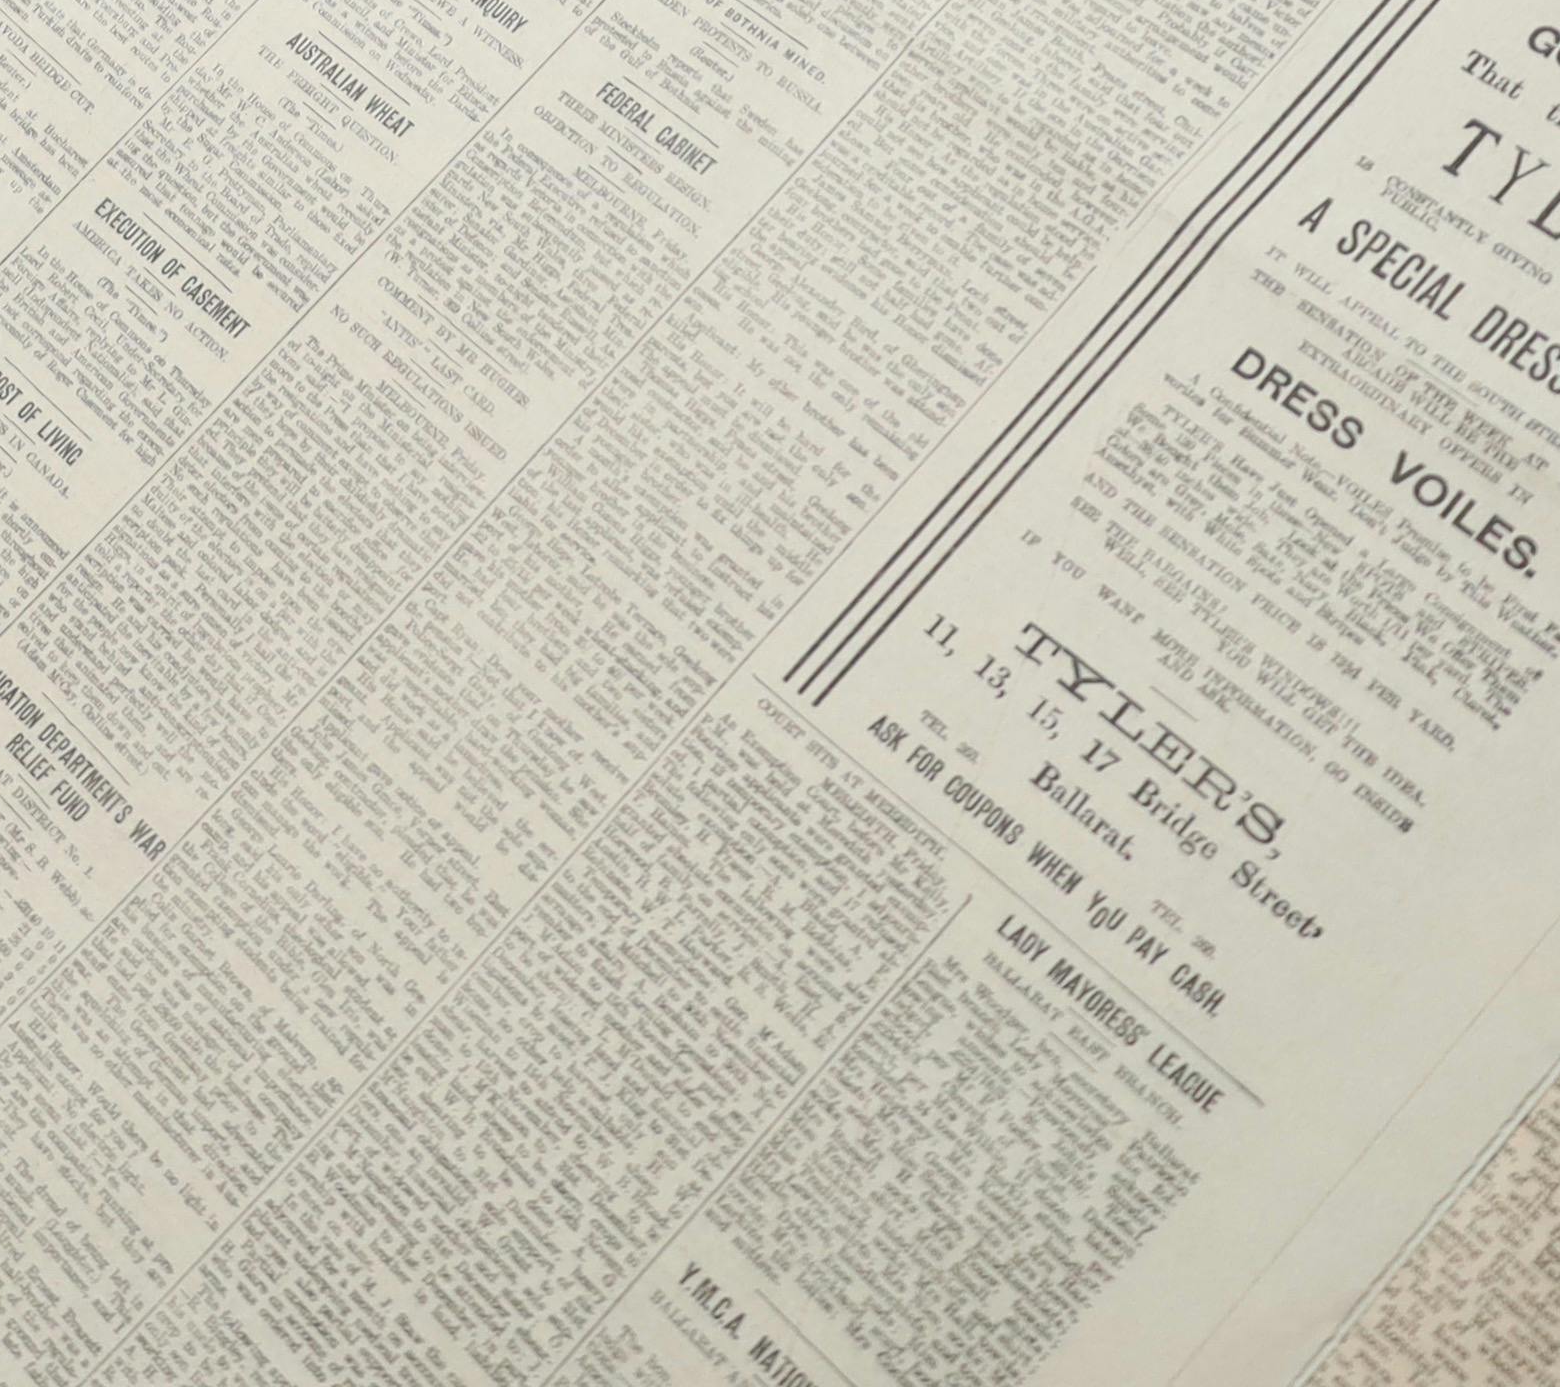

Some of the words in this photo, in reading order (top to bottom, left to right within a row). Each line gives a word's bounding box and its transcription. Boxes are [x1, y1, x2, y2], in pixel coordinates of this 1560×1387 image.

[1460, 48, 1525, 101] That
[93, 195, 168, 266] EXECUTION
[159, 256, 188, 281] OF
[179, 274, 253, 340] CASEMENT
[1296, 196, 1335, 235] A
[1335, 218, 1467, 322] SPECIAL
[1229, 345, 1365, 451] DRESS
[1389, 449, 1539, 580] VOILES.
[866, 714, 910, 754] ASK
[904, 743, 946, 783] FOR
[942, 773, 1026, 847] COUPONS
[1025, 839, 1085, 896] WHEN
[1084, 888, 1130, 933] YOU
[1123, 924, 1172, 967] PAY
[922, 612, 960, 659] 11,
[972, 653, 1013, 700] 13,
[1027, 697, 1064, 741] 15,
[1078, 737, 1123, 774] 17
[1127, 776, 1219, 861] Bridge
[1013, 620, 1287, 862] TYLER'S,
